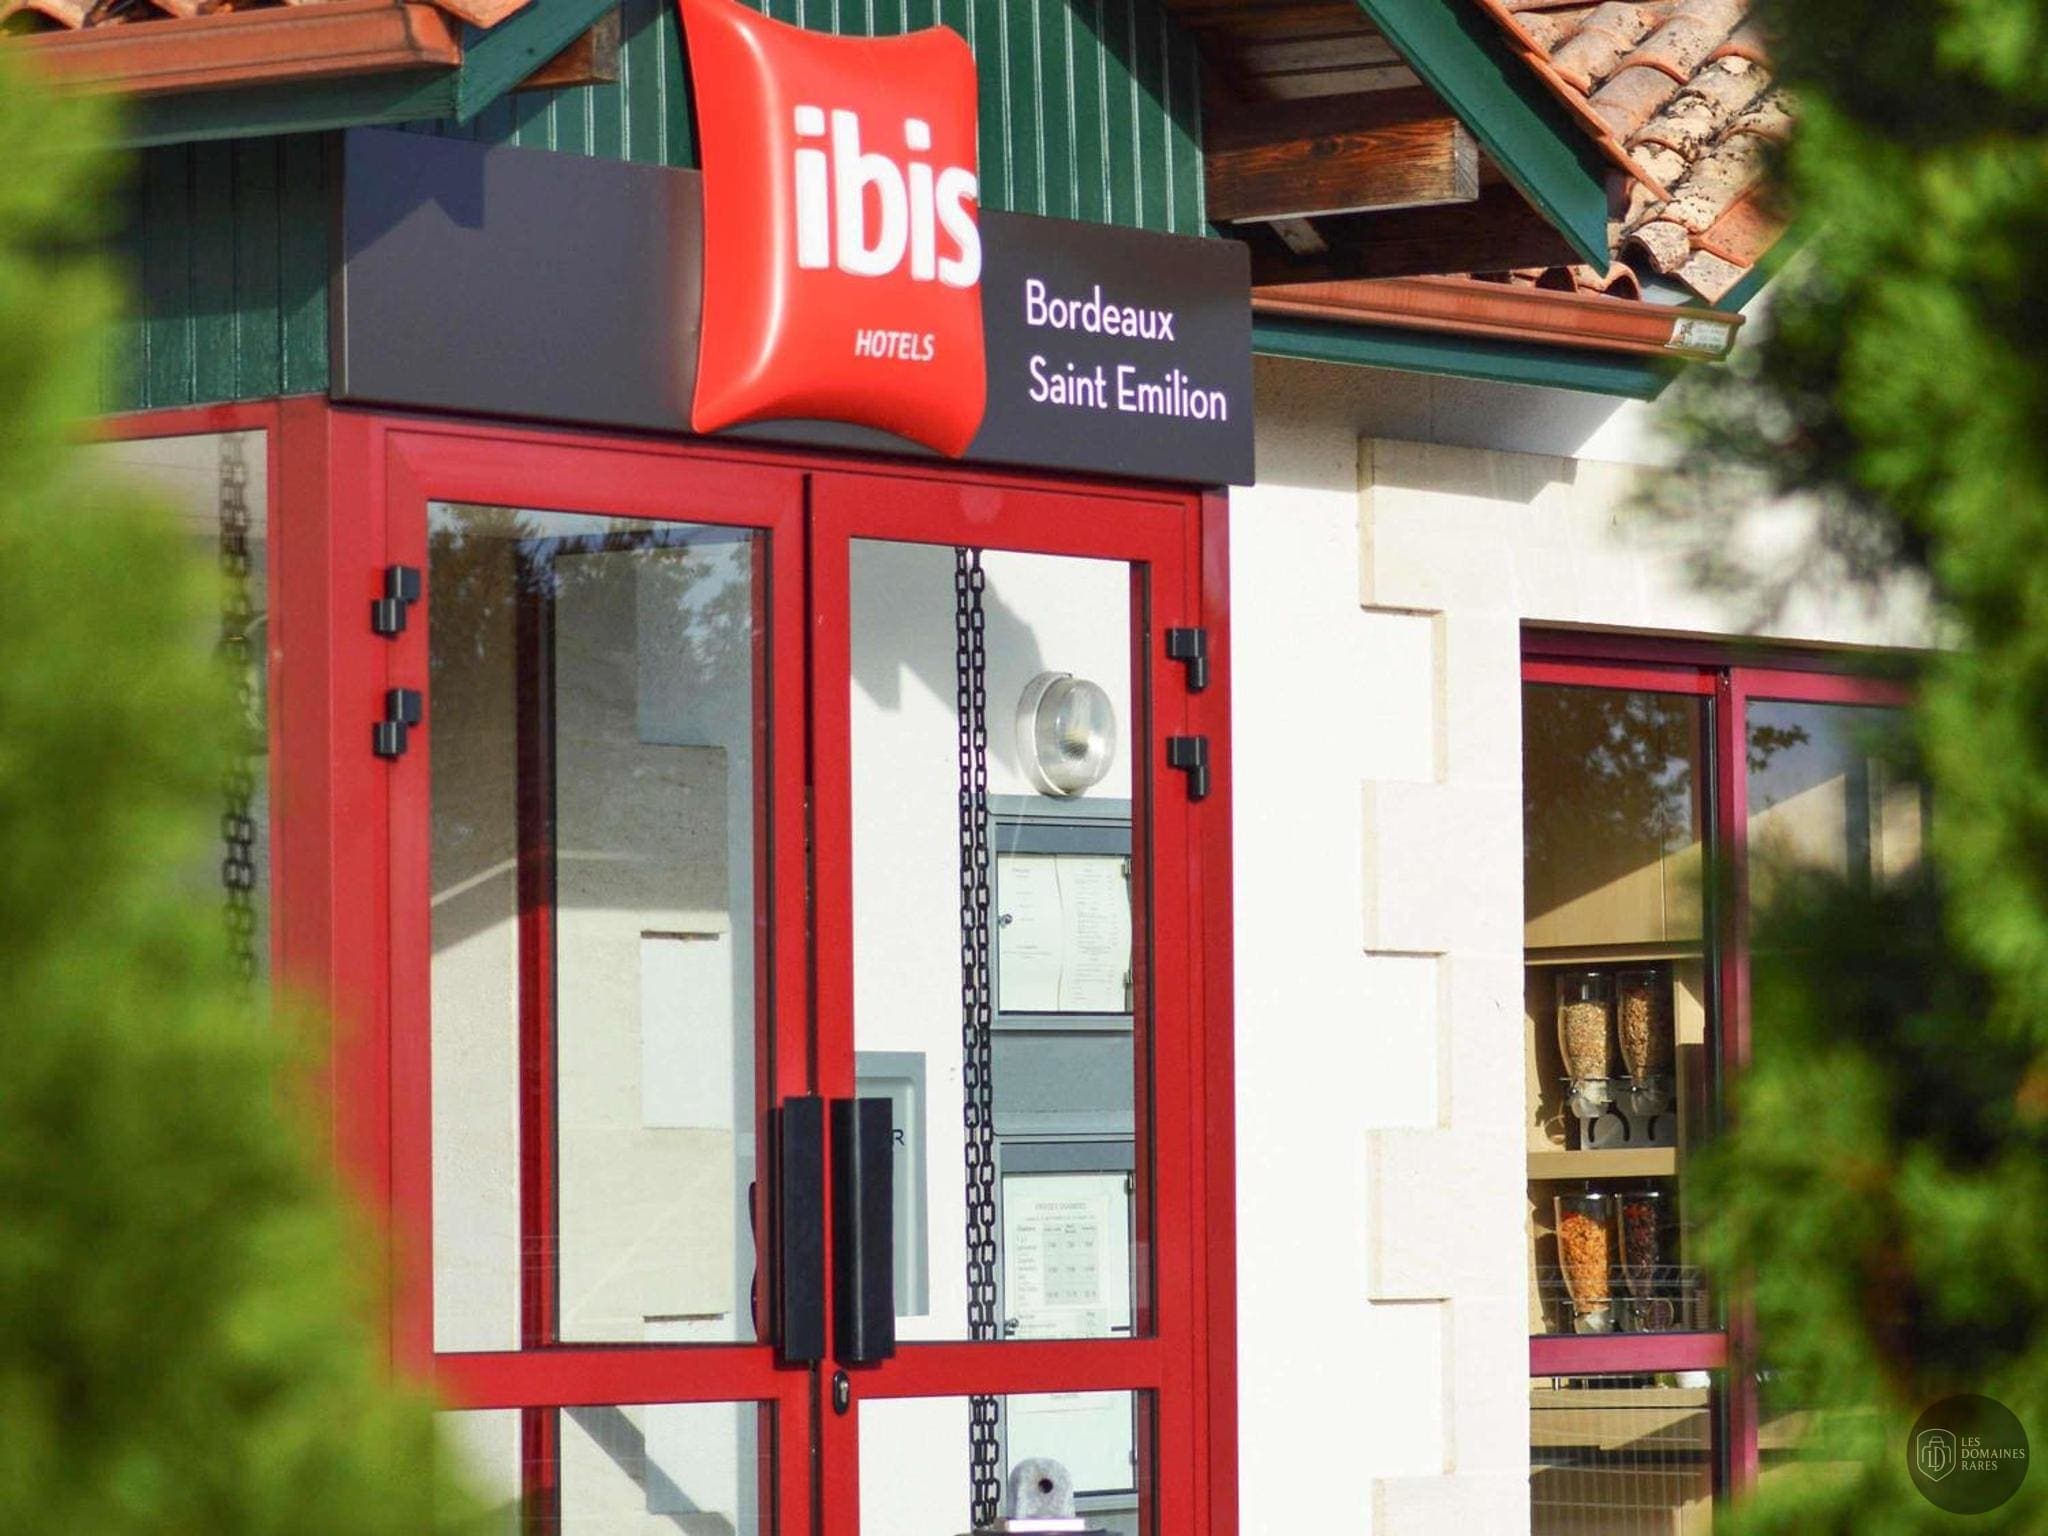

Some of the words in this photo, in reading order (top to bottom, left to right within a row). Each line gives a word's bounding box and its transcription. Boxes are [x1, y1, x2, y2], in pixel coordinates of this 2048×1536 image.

[794, 105, 982, 287] ibis
[1026, 278, 1175, 341] Bordeaux
[855, 330, 935, 362] HOTELS
[1029, 356, 1108, 409] Saint
[1117, 365, 1228, 422] Emilion
